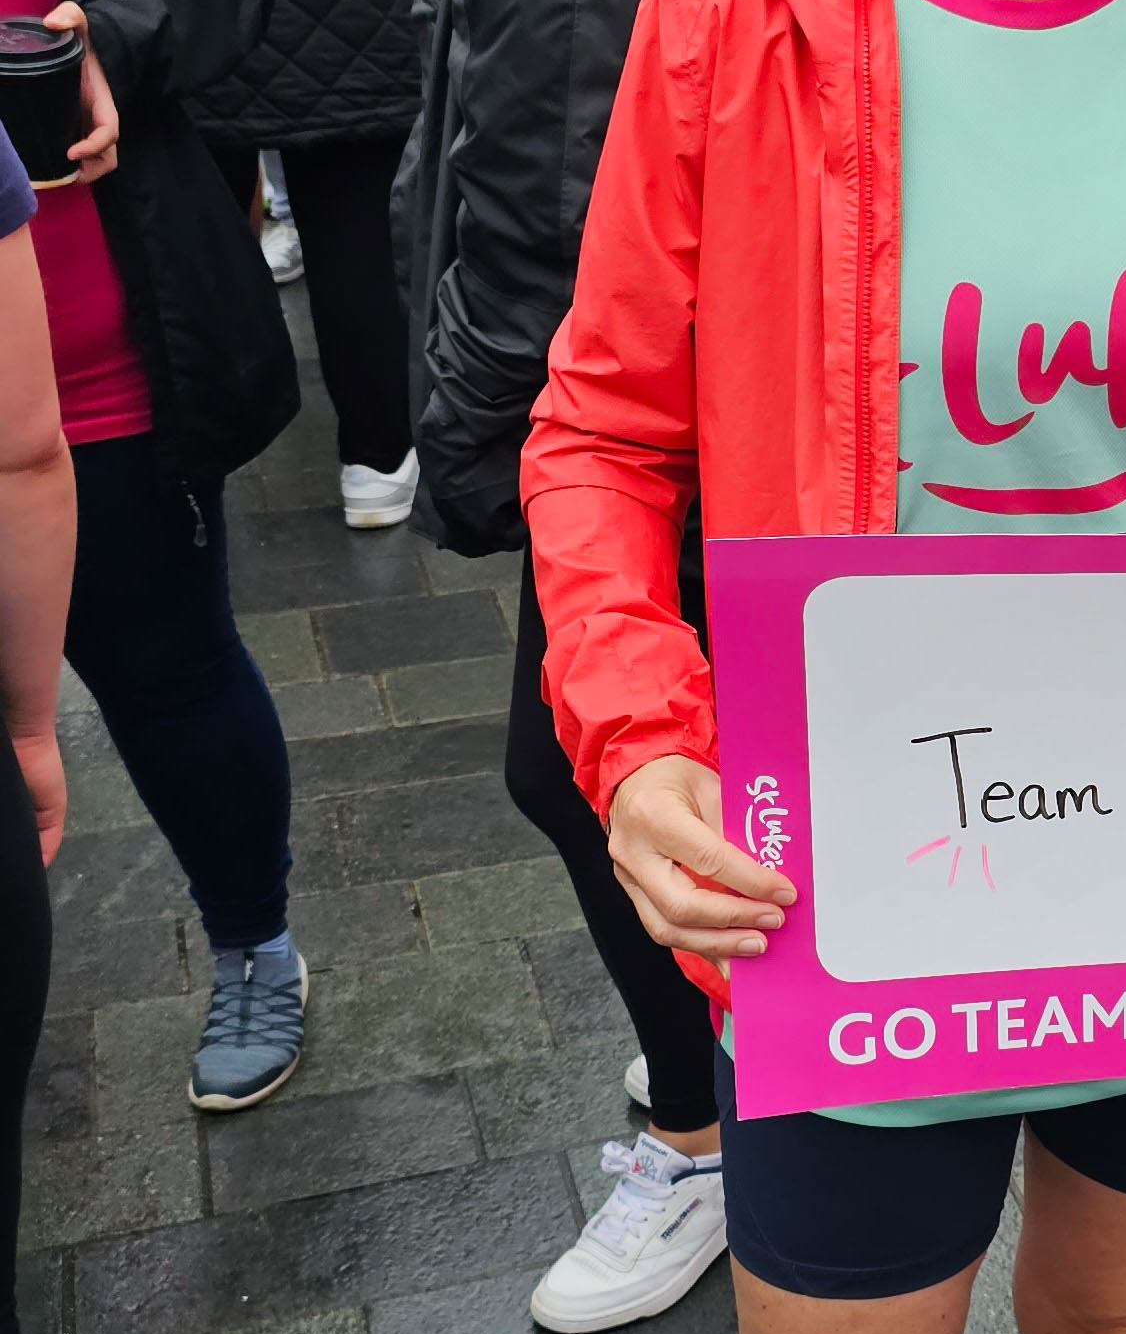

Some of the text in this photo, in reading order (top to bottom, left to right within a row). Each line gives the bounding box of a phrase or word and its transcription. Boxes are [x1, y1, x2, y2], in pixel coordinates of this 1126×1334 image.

[746, 775, 780, 806] St
[911, 727, 1115, 829] Team
[828, 1007, 937, 1065] GO
